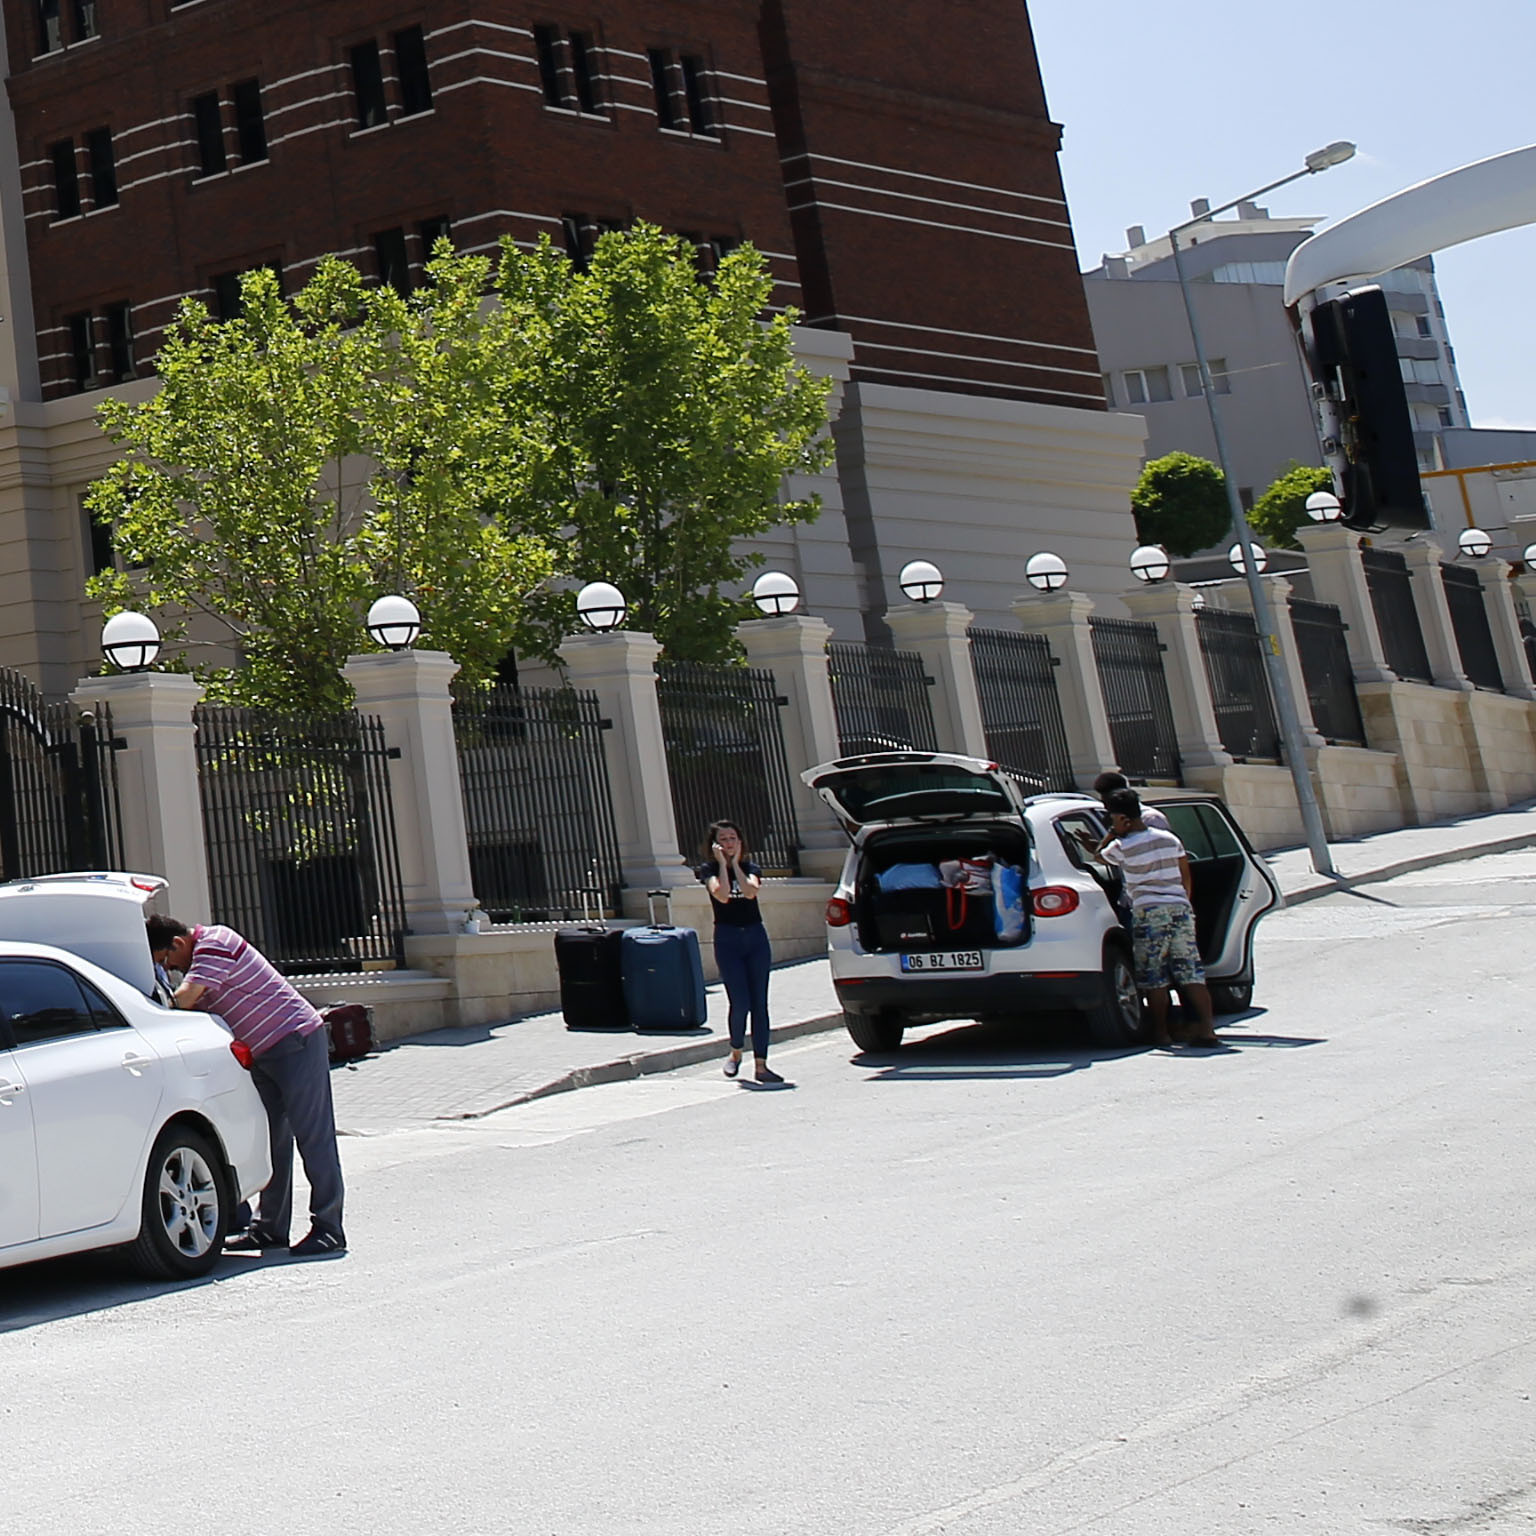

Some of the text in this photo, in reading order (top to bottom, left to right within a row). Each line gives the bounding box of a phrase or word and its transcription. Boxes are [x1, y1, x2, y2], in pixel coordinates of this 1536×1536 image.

[908, 952, 979, 968] 06 BZ 1825
